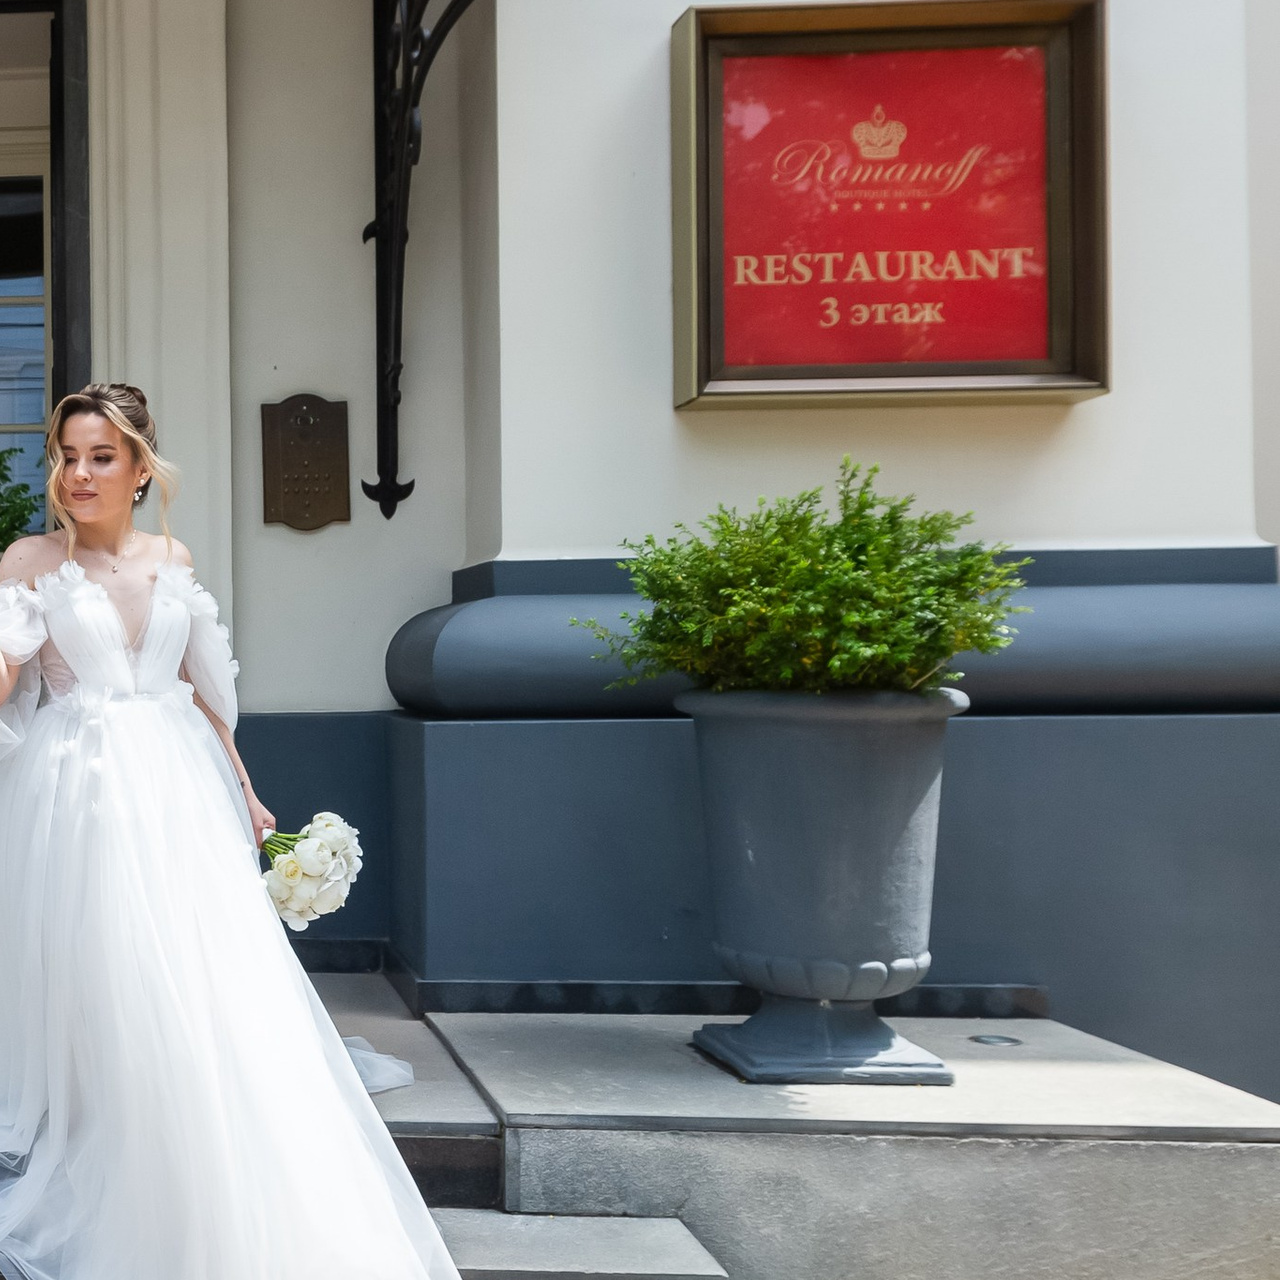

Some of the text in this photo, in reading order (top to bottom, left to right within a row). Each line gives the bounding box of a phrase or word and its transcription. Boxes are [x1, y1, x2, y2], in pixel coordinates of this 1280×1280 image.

[771, 139, 992, 196] Romanoff
[733, 247, 1035, 285] RESTAURANT
[820, 297, 946, 328] 3 этаж
